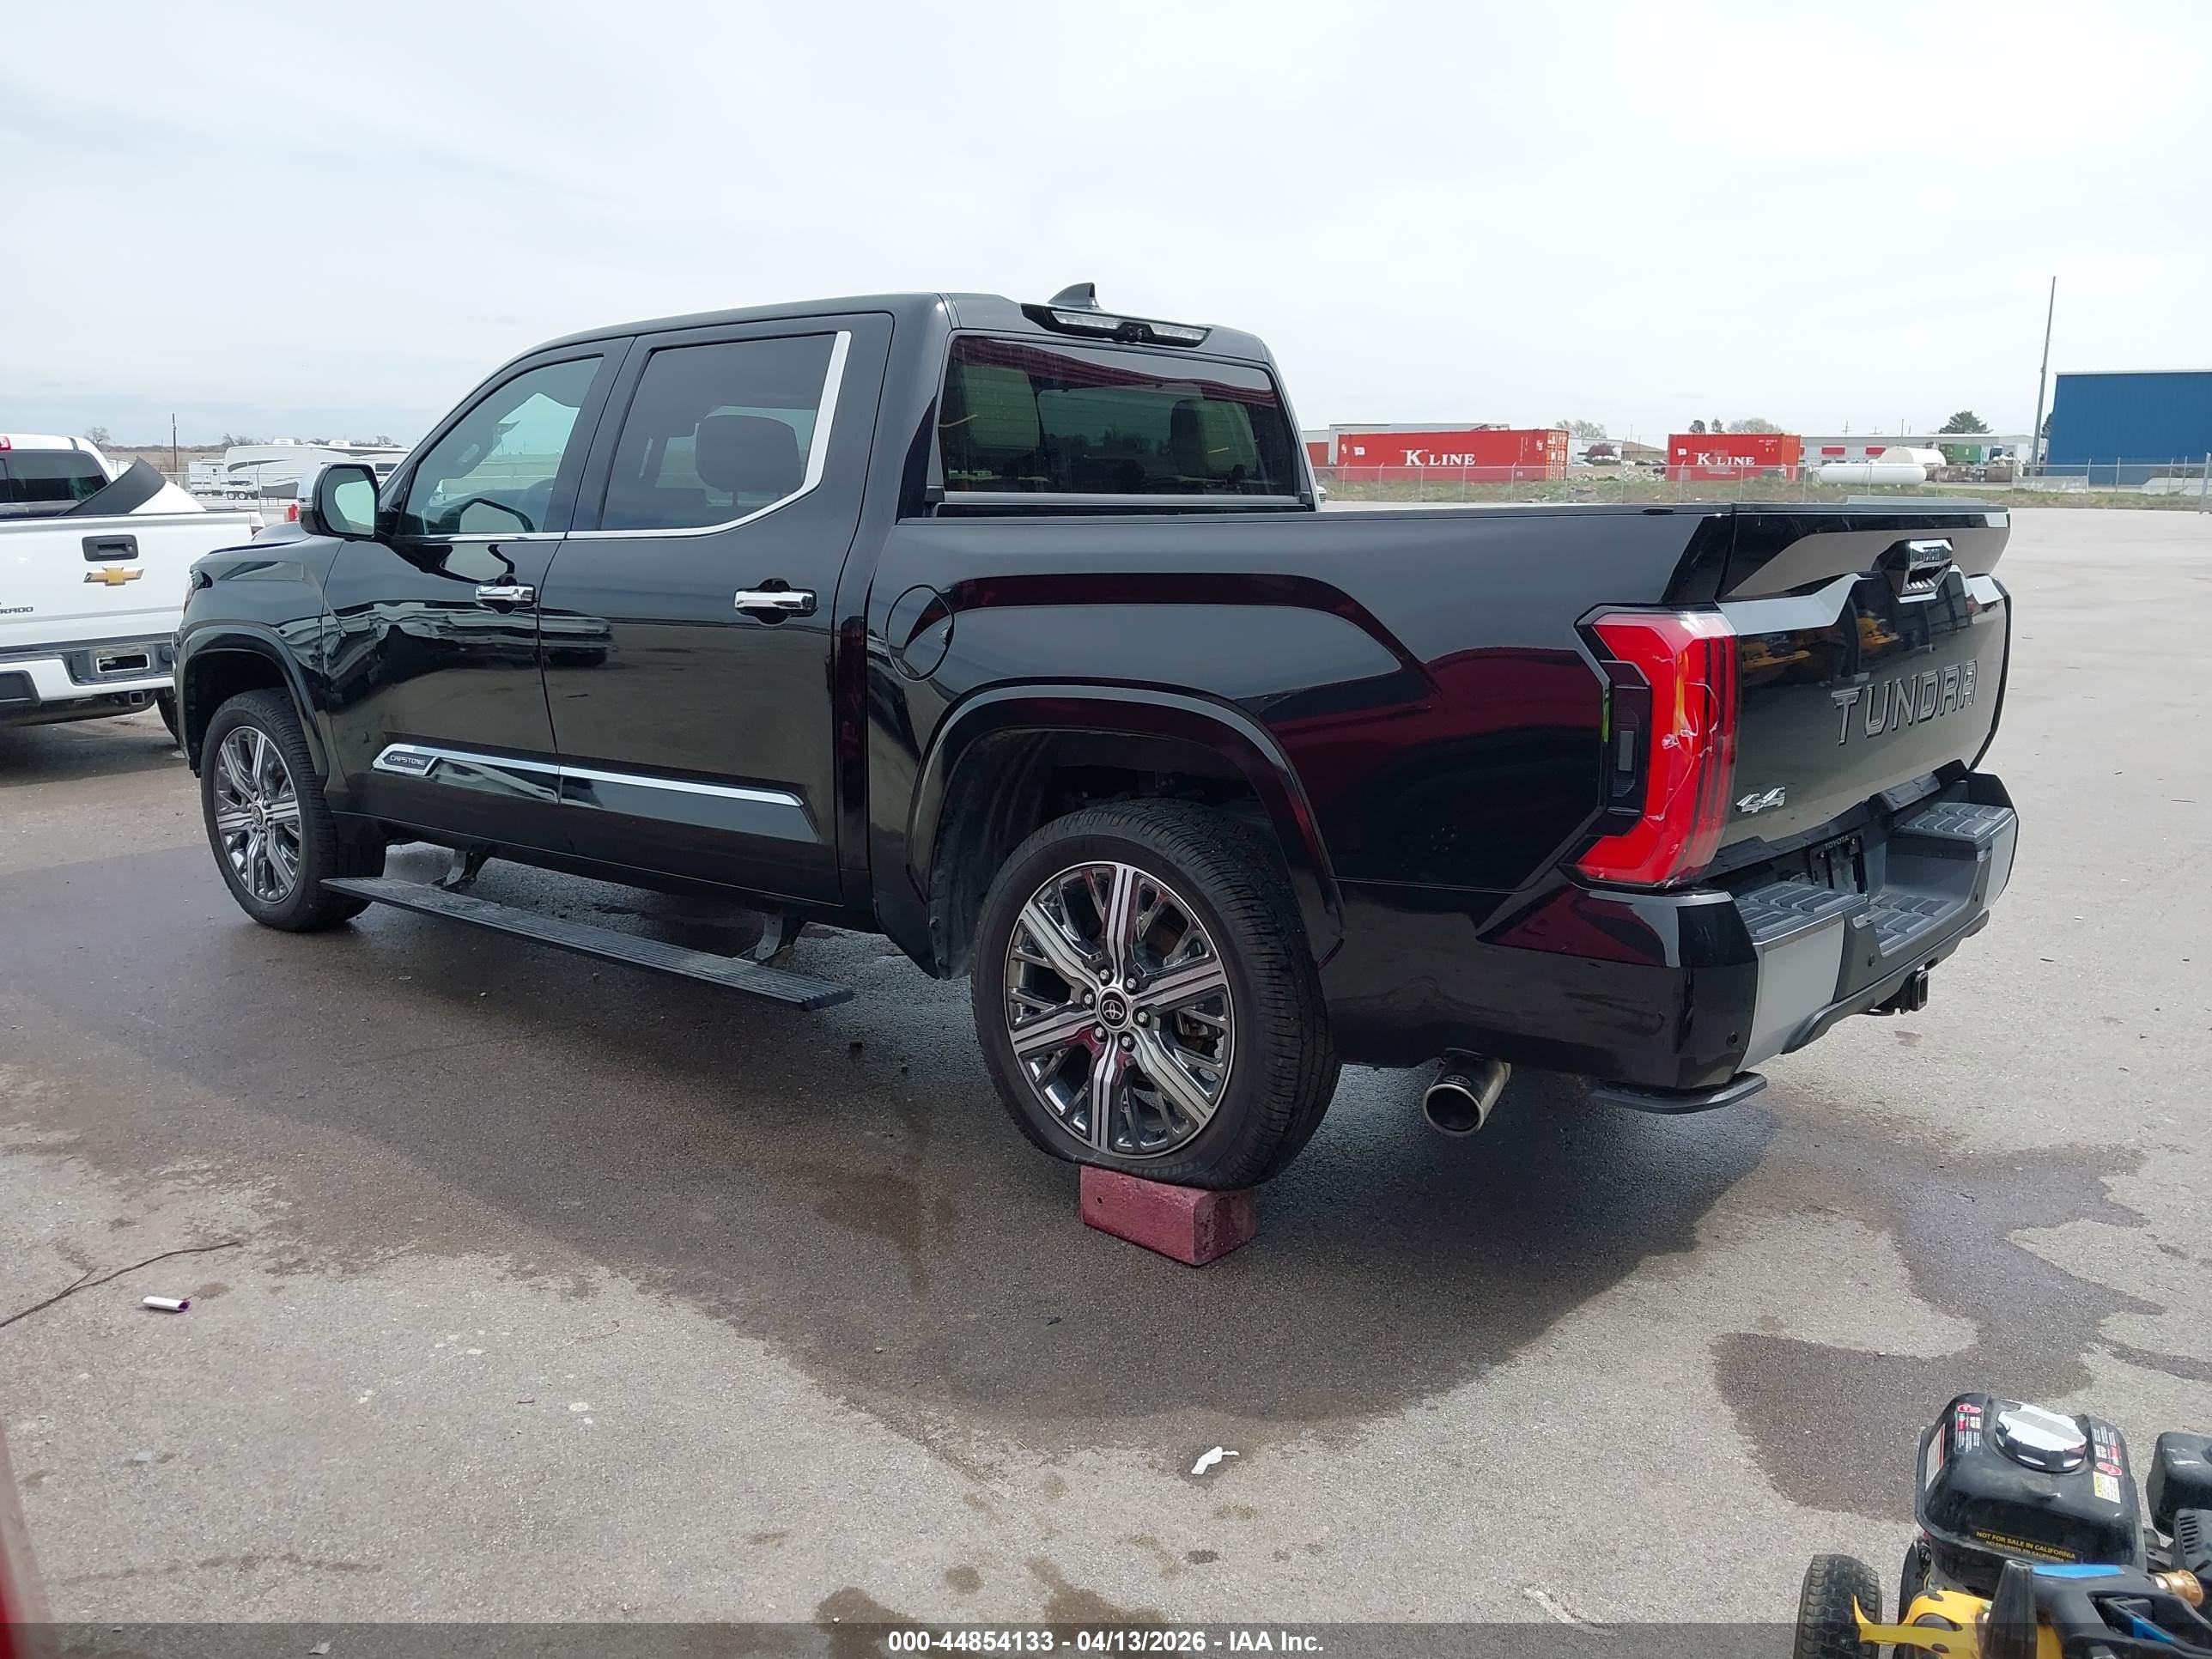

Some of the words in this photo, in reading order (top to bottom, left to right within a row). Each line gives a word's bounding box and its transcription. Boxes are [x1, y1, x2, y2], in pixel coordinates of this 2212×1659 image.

[1428, 453, 1476, 465] LINE
[1717, 456, 1754, 465] LINE
[1831, 659, 1978, 746] TUNDRA
[390, 755, 426, 766] CAPSTONE
[1824, 835, 1850, 850] TOYOTA
[1976, 1531, 1991, 1540] NOT
[1992, 1534, 2006, 1543] FOR
[2007, 1538, 2025, 1547] SALE
[2034, 1545, 2075, 1559] CALIFORNIA
